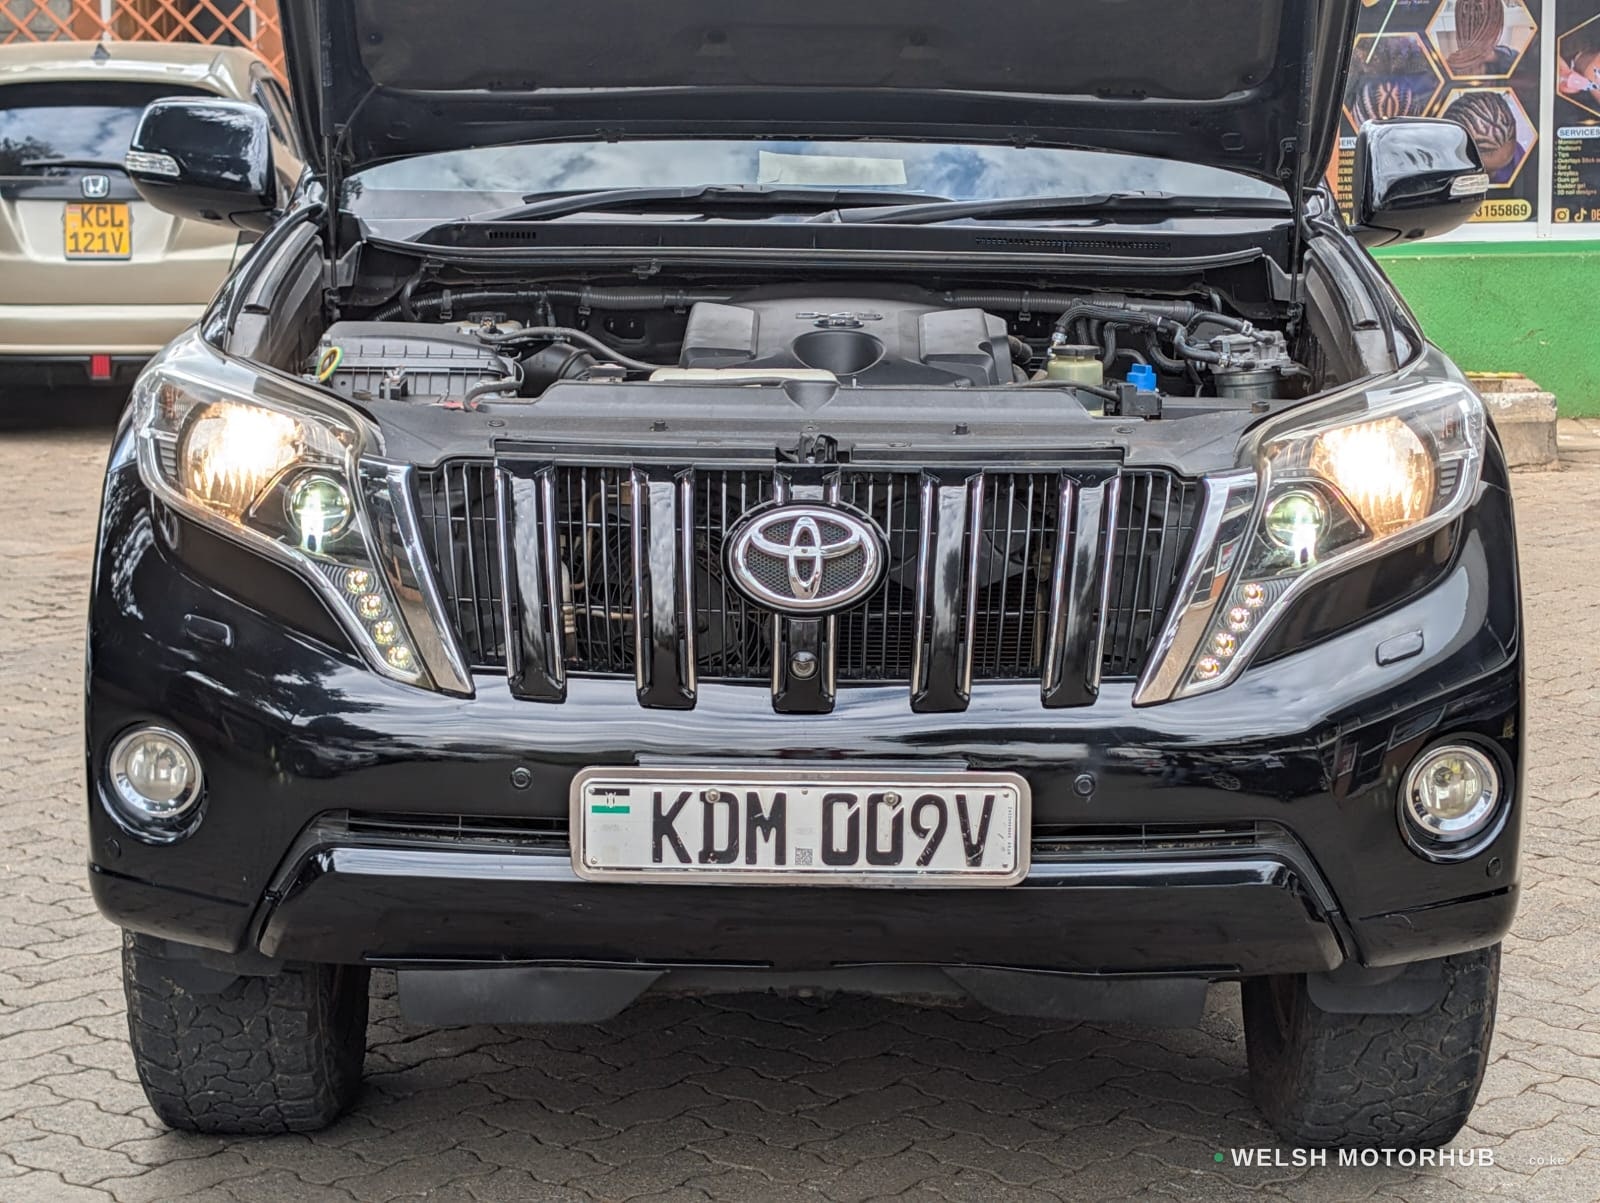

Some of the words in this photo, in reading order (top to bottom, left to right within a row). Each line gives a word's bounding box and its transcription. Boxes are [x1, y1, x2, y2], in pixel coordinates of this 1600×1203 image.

[81, 205, 124, 228] KCL
[68, 231, 124, 253] 121V
[652, 791, 787, 866] KDM
[821, 792, 996, 867] 009V
